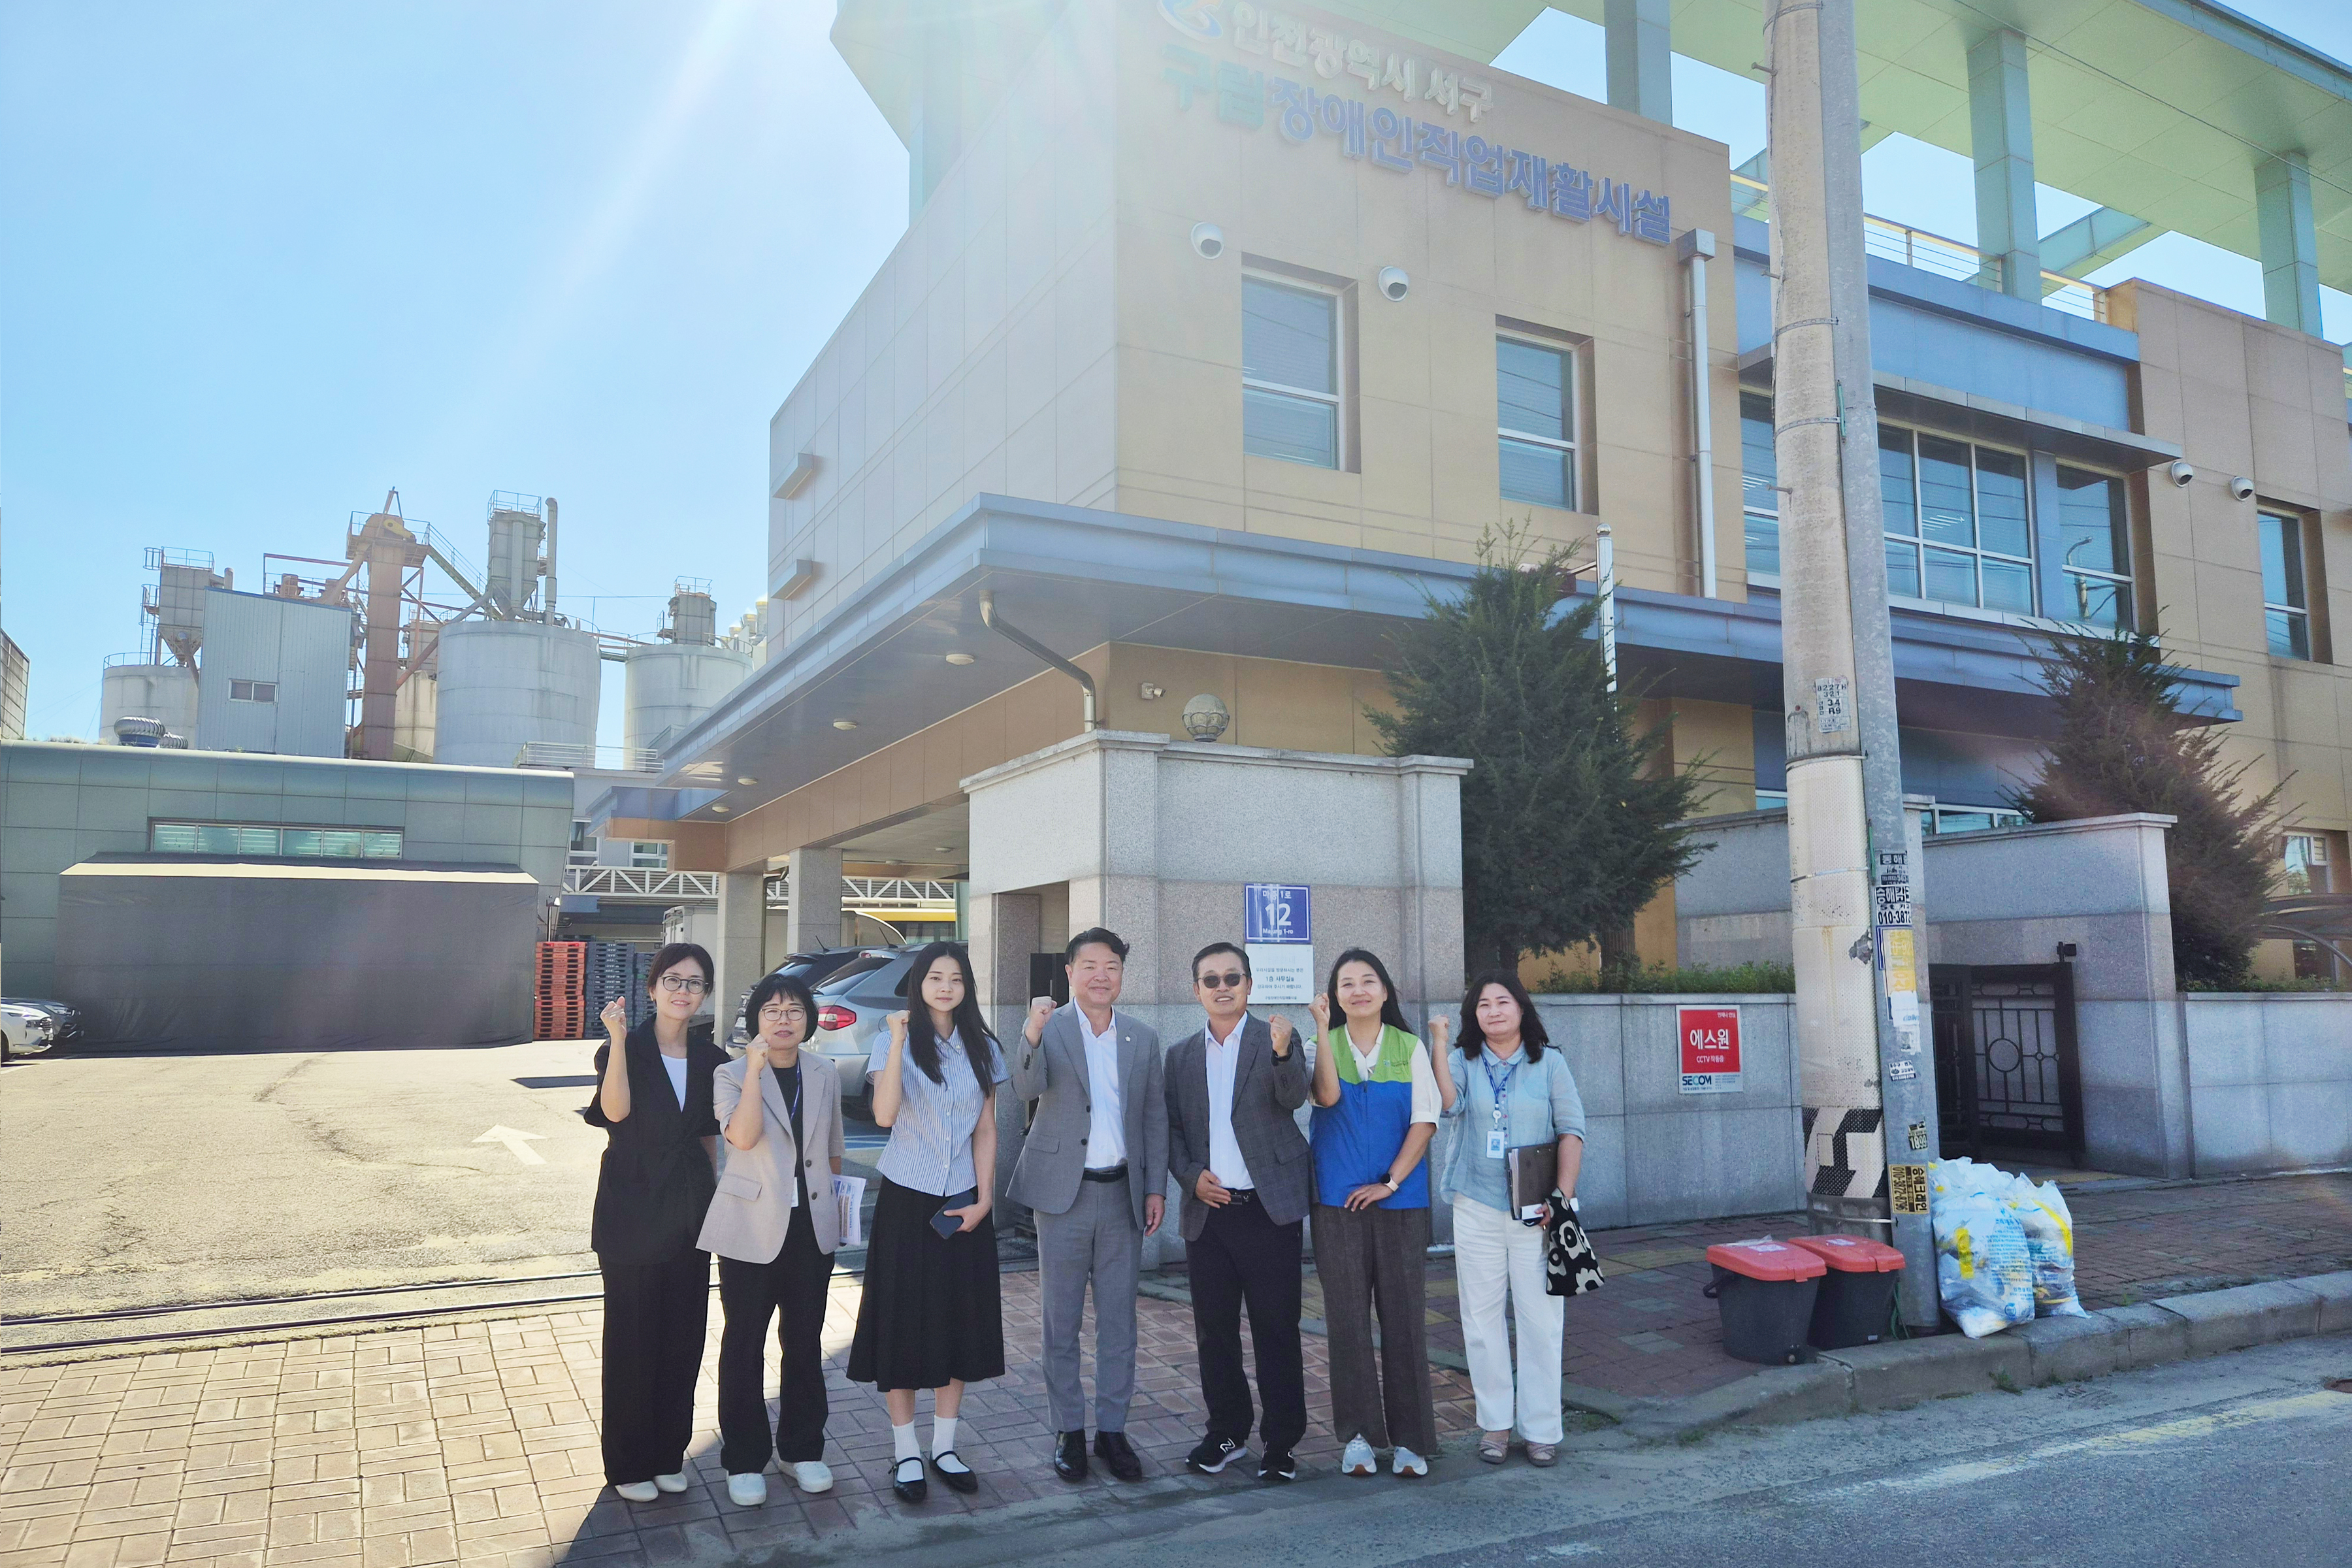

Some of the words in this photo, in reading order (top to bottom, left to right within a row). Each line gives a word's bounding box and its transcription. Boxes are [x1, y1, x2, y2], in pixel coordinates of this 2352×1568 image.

[1233, 1, 1415, 103] 인천광역시
[1424, 67, 1494, 124] 서구
[1265, 903, 1292, 926] 12
[1690, 1028, 1729, 1050] 에스원
[1682, 1075, 1712, 1086] SECOM
